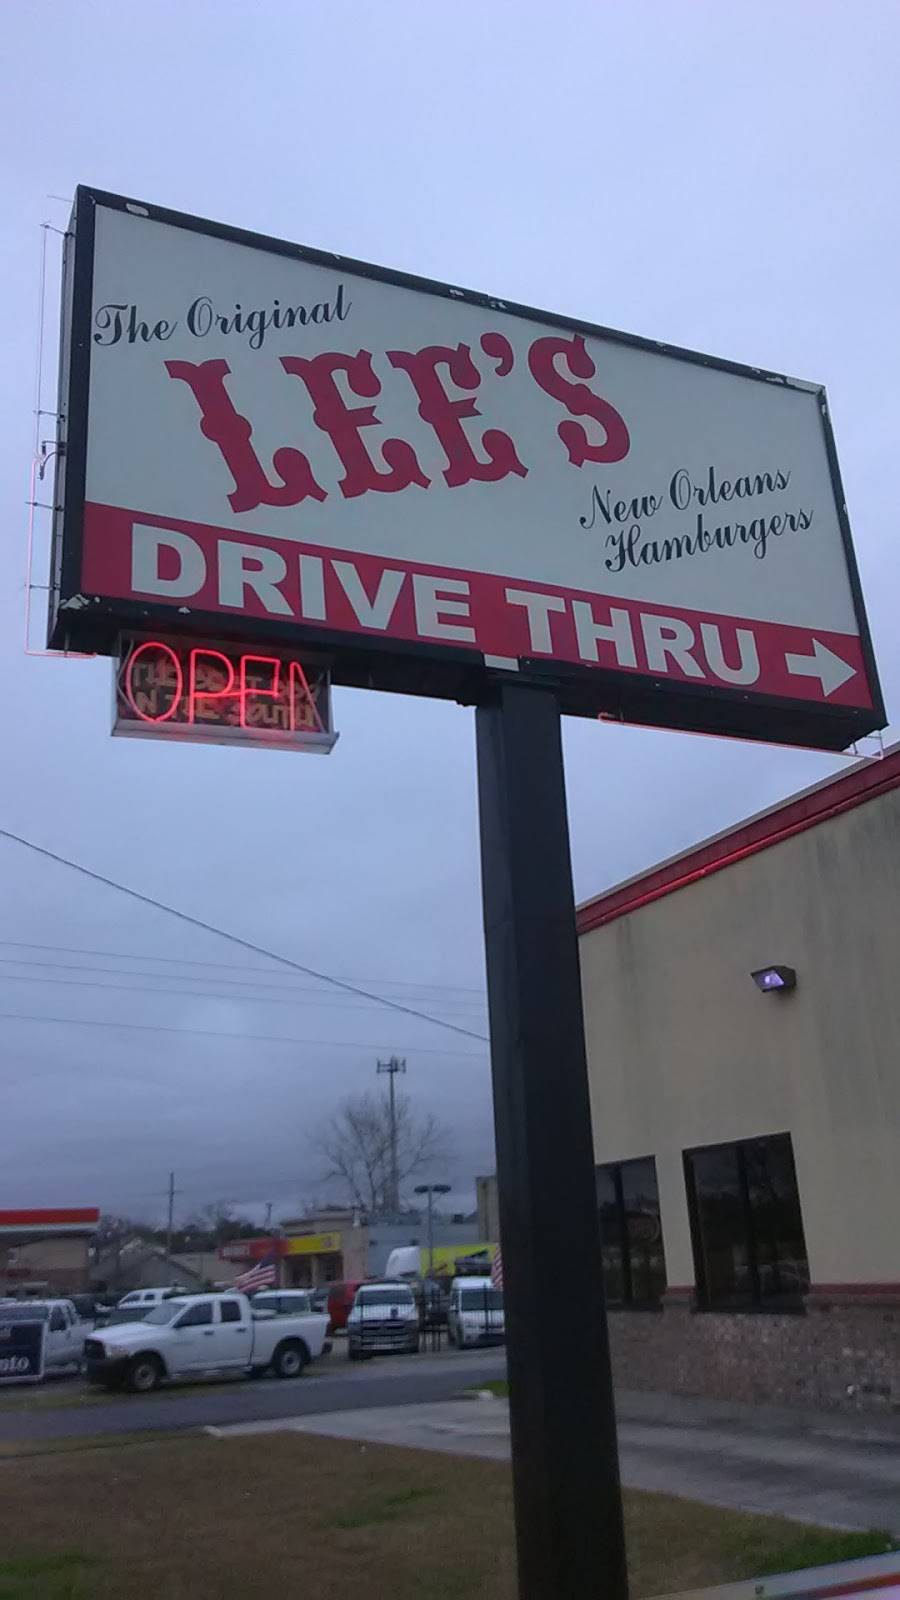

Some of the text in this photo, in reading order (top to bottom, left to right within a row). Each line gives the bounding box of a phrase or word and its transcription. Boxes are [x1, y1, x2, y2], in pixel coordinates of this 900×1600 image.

[94, 284, 352, 350] The Original
[164, 332, 630, 513] LEE'S
[579, 466, 791, 529] New Orleans
[605, 508, 814, 573] Hamburgers
[131, 523, 760, 686] DRIVE THRU
[126, 641, 327, 734] OPEN
